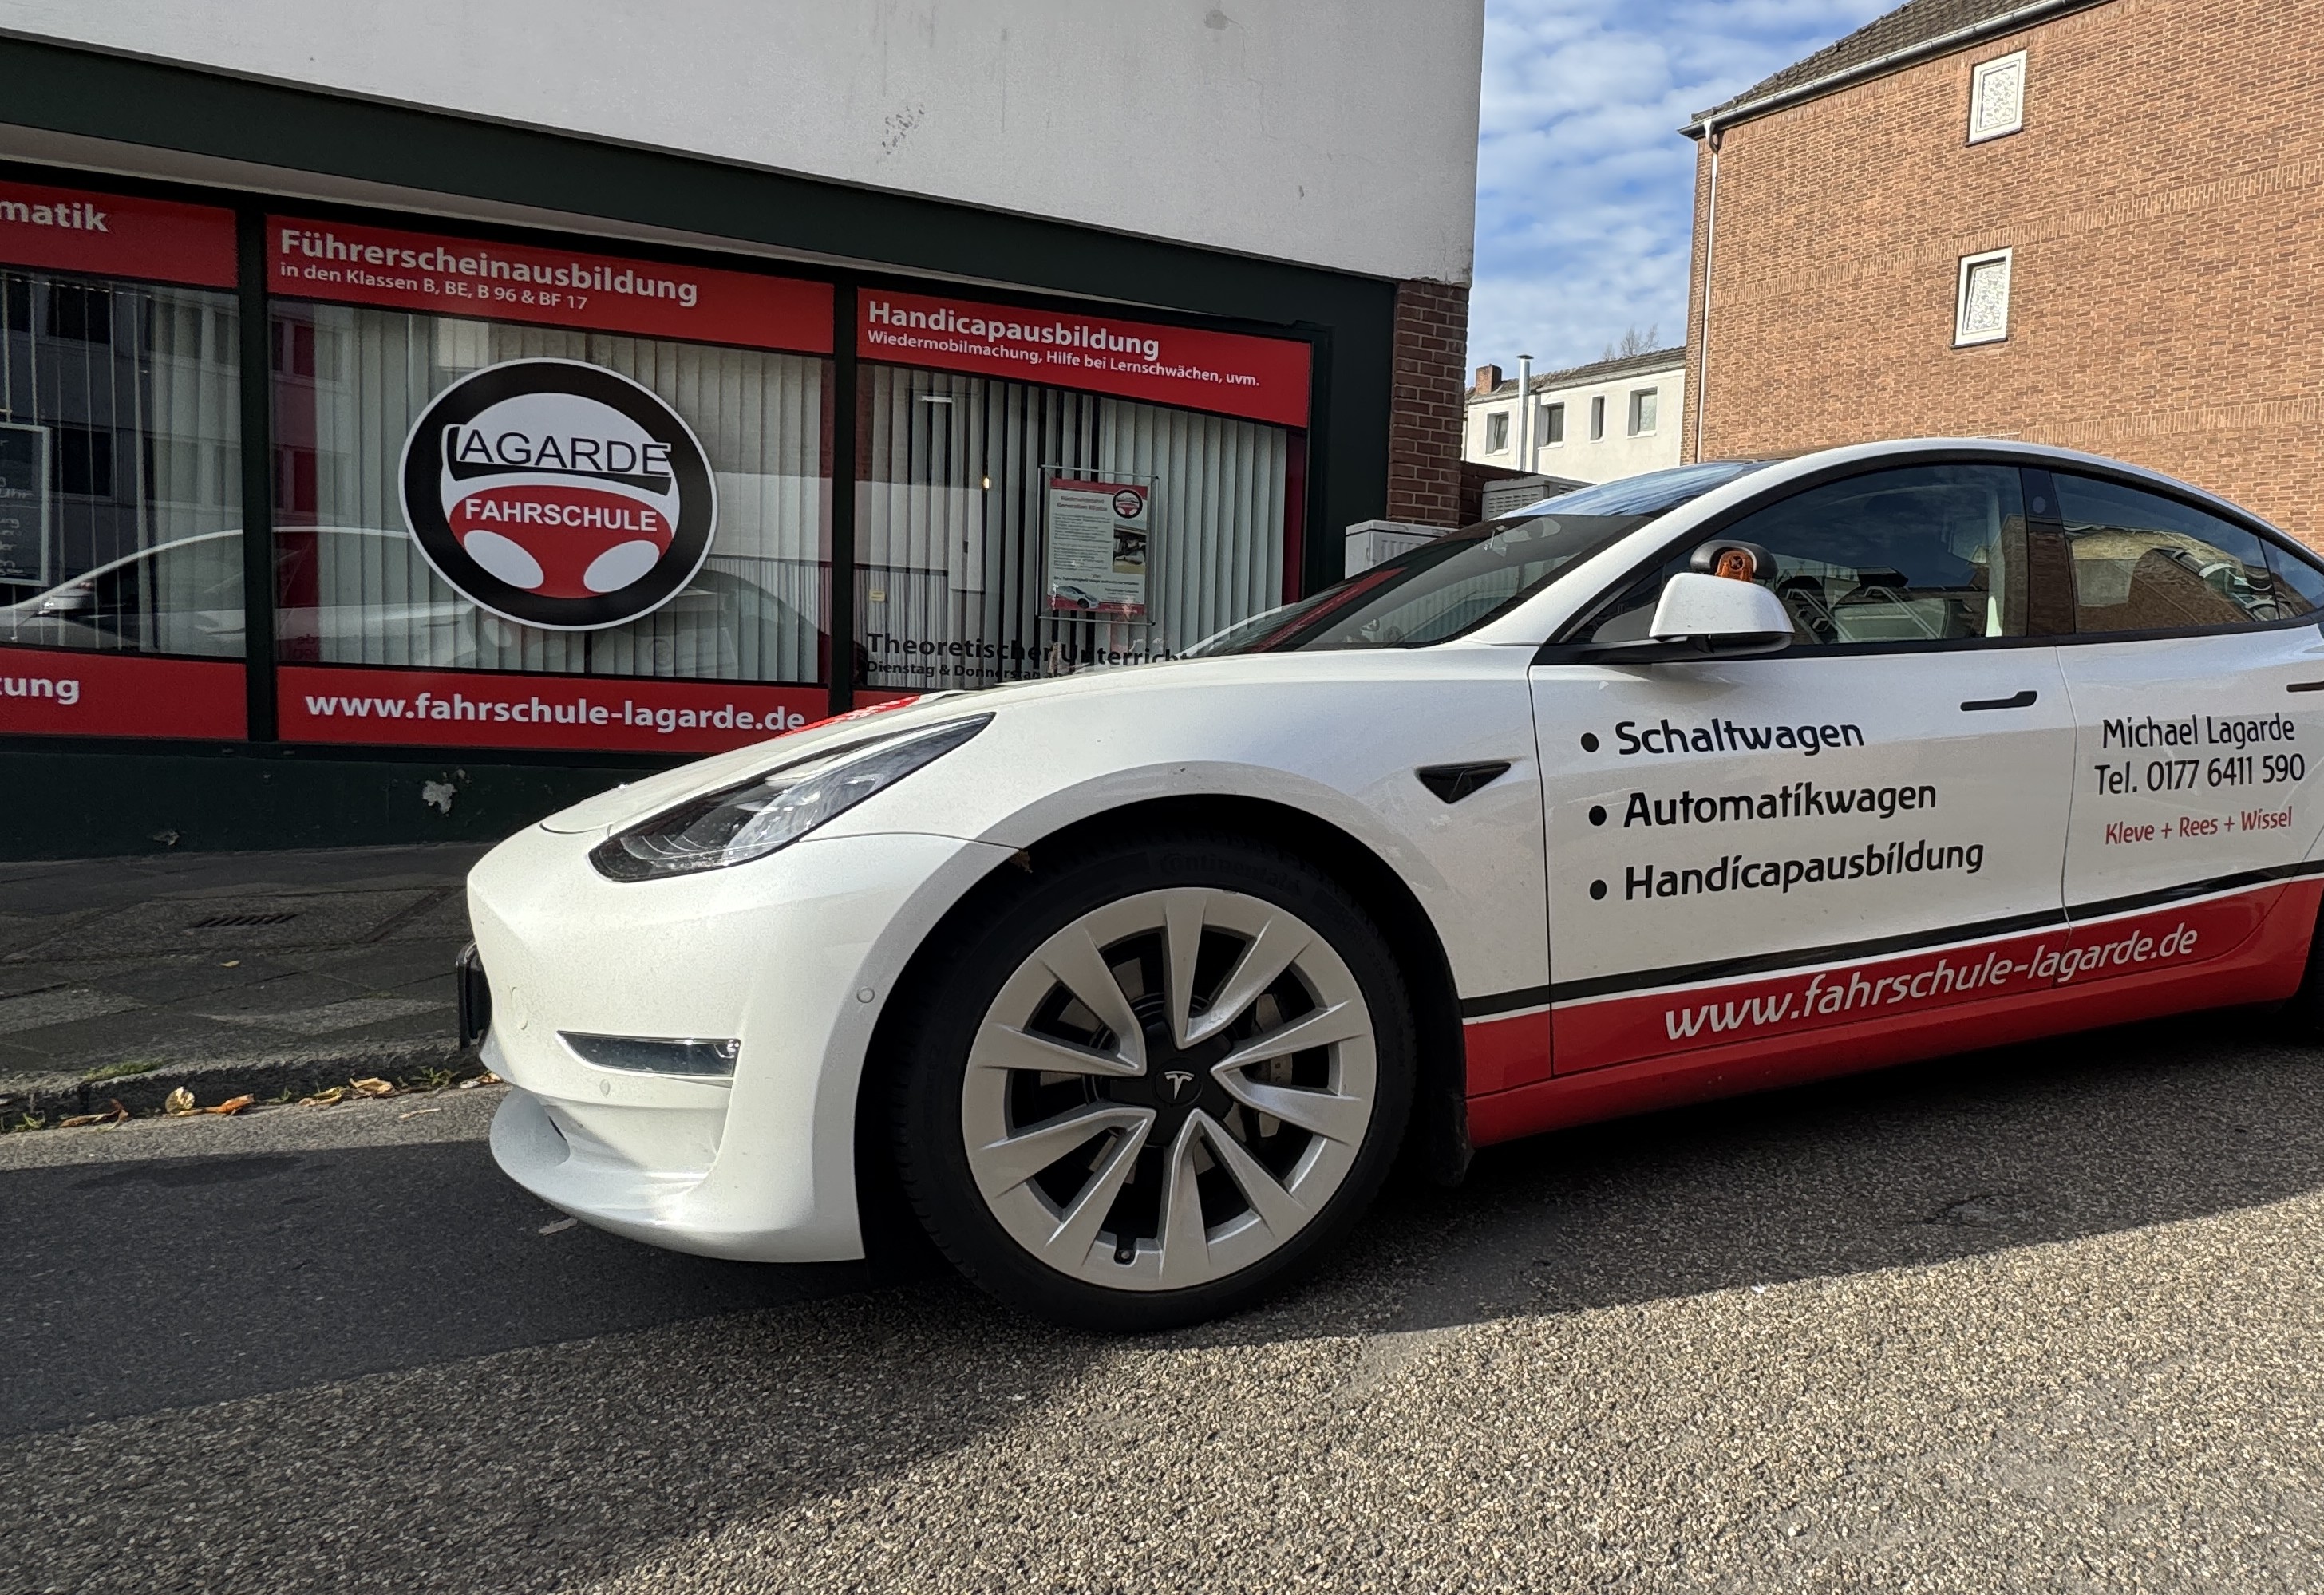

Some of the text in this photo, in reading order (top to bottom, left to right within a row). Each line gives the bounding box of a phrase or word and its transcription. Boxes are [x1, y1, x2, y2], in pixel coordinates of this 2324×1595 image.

[280, 261, 587, 310] in den Klassen B, BE, B 96 & BF 17
[281, 228, 698, 308] Führerscheinausbildung
[868, 300, 1160, 361] Handicapausbildung
[867, 329, 1260, 387] Wiedermobilmachung, Hilfe bei Lernschwächen, uvm.
[446, 426, 672, 496] LAGARDE
[465, 499, 658, 532] FAHRSCHULE
[867, 632, 1053, 661] Theoretischer
[867, 660, 935, 678] Dienstag
[939, 664, 951, 677] &
[0, 677, 79, 705] ung
[305, 692, 805, 733] www.fahrschule-lagarde.de
[1615, 718, 1864, 756] Schaltwagen
[2102, 712, 2295, 750] Michael Lagarde
[2094, 752, 2306, 795] Tel. 0177 6411 590
[1623, 781, 1937, 828] Automatikwagen
[2105, 806, 2293, 845] Kleve + Rees + Wissel
[1626, 839, 1985, 901] Handicapausbildung
[1665, 922, 2198, 1040] www.fahrschule-lagarde.de
